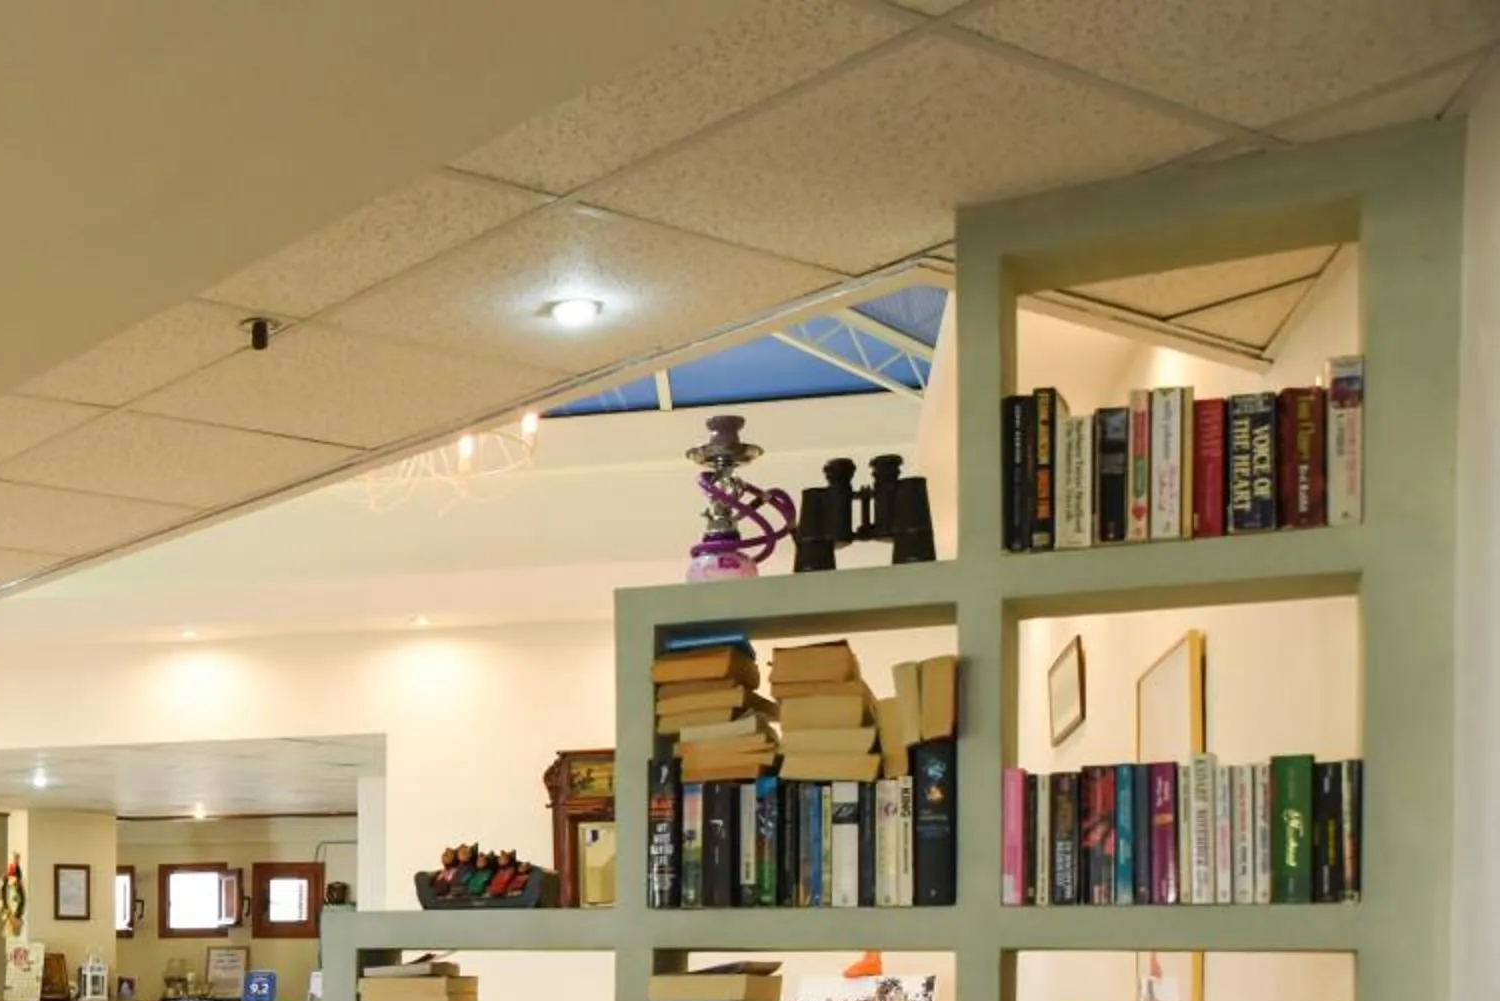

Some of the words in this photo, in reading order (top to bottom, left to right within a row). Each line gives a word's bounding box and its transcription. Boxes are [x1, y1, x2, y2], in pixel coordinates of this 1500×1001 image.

[1233, 416, 1250, 449] THE
[1253, 424, 1270, 473] VOICE
[1233, 454, 1250, 511] HEART
[1254, 478, 1270, 500] OF
